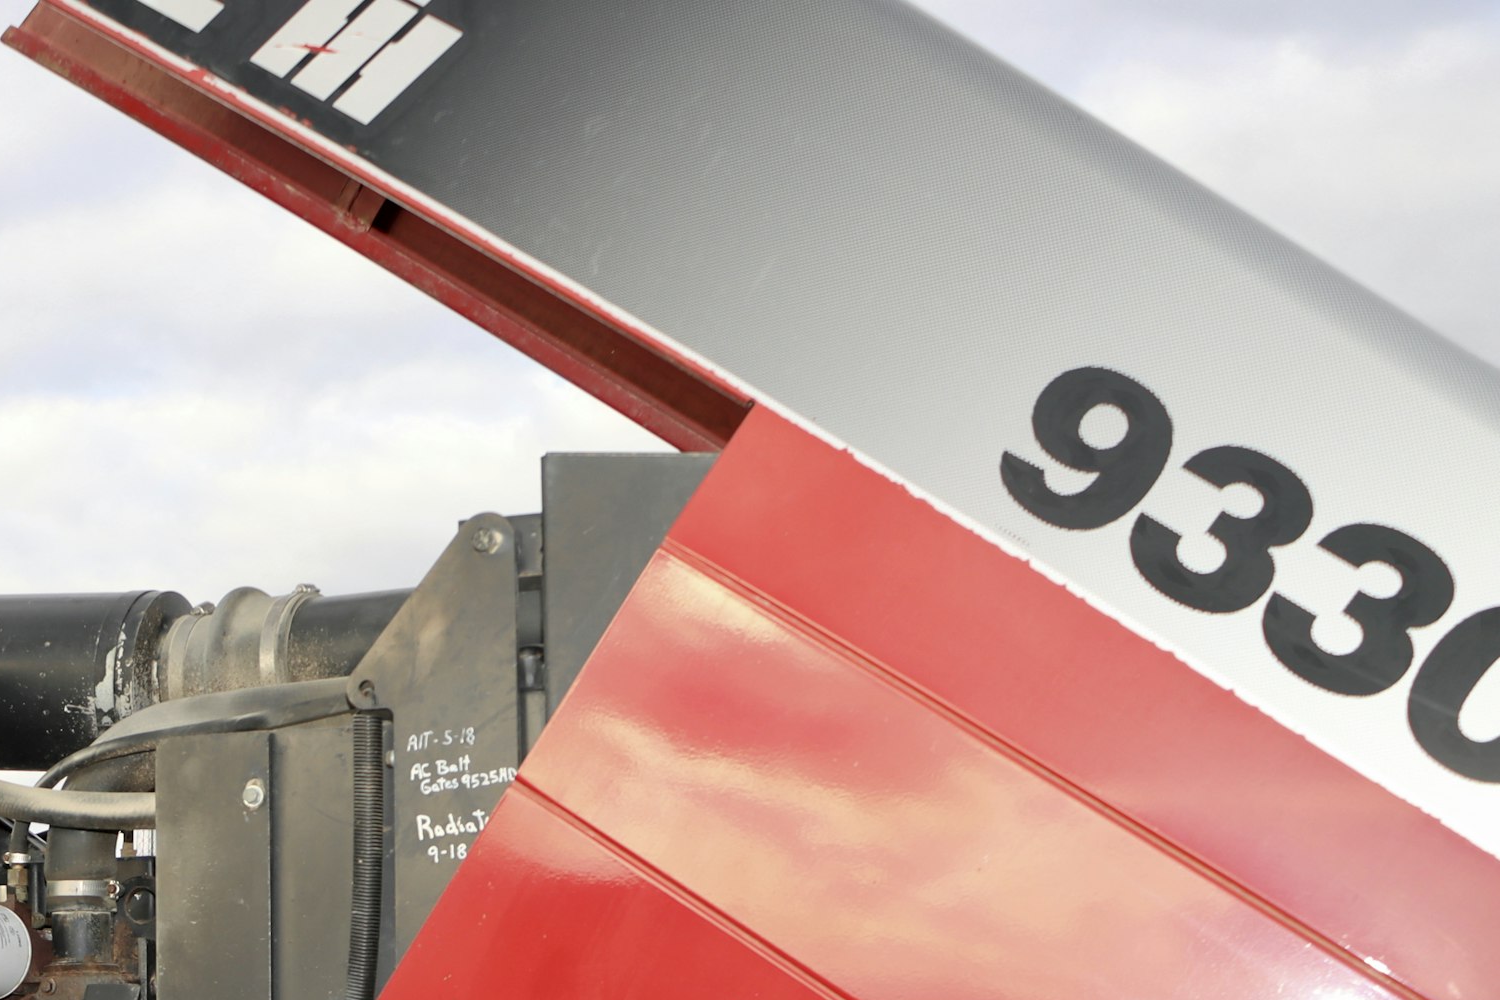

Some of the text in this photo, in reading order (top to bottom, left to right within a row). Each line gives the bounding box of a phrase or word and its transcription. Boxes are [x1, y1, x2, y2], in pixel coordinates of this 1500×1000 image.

[1000, 366, 1500, 784] 9330
[410, 762, 431, 781] AC
[420, 776, 459, 795] Gates
[416, 808, 489, 841] Radiat
